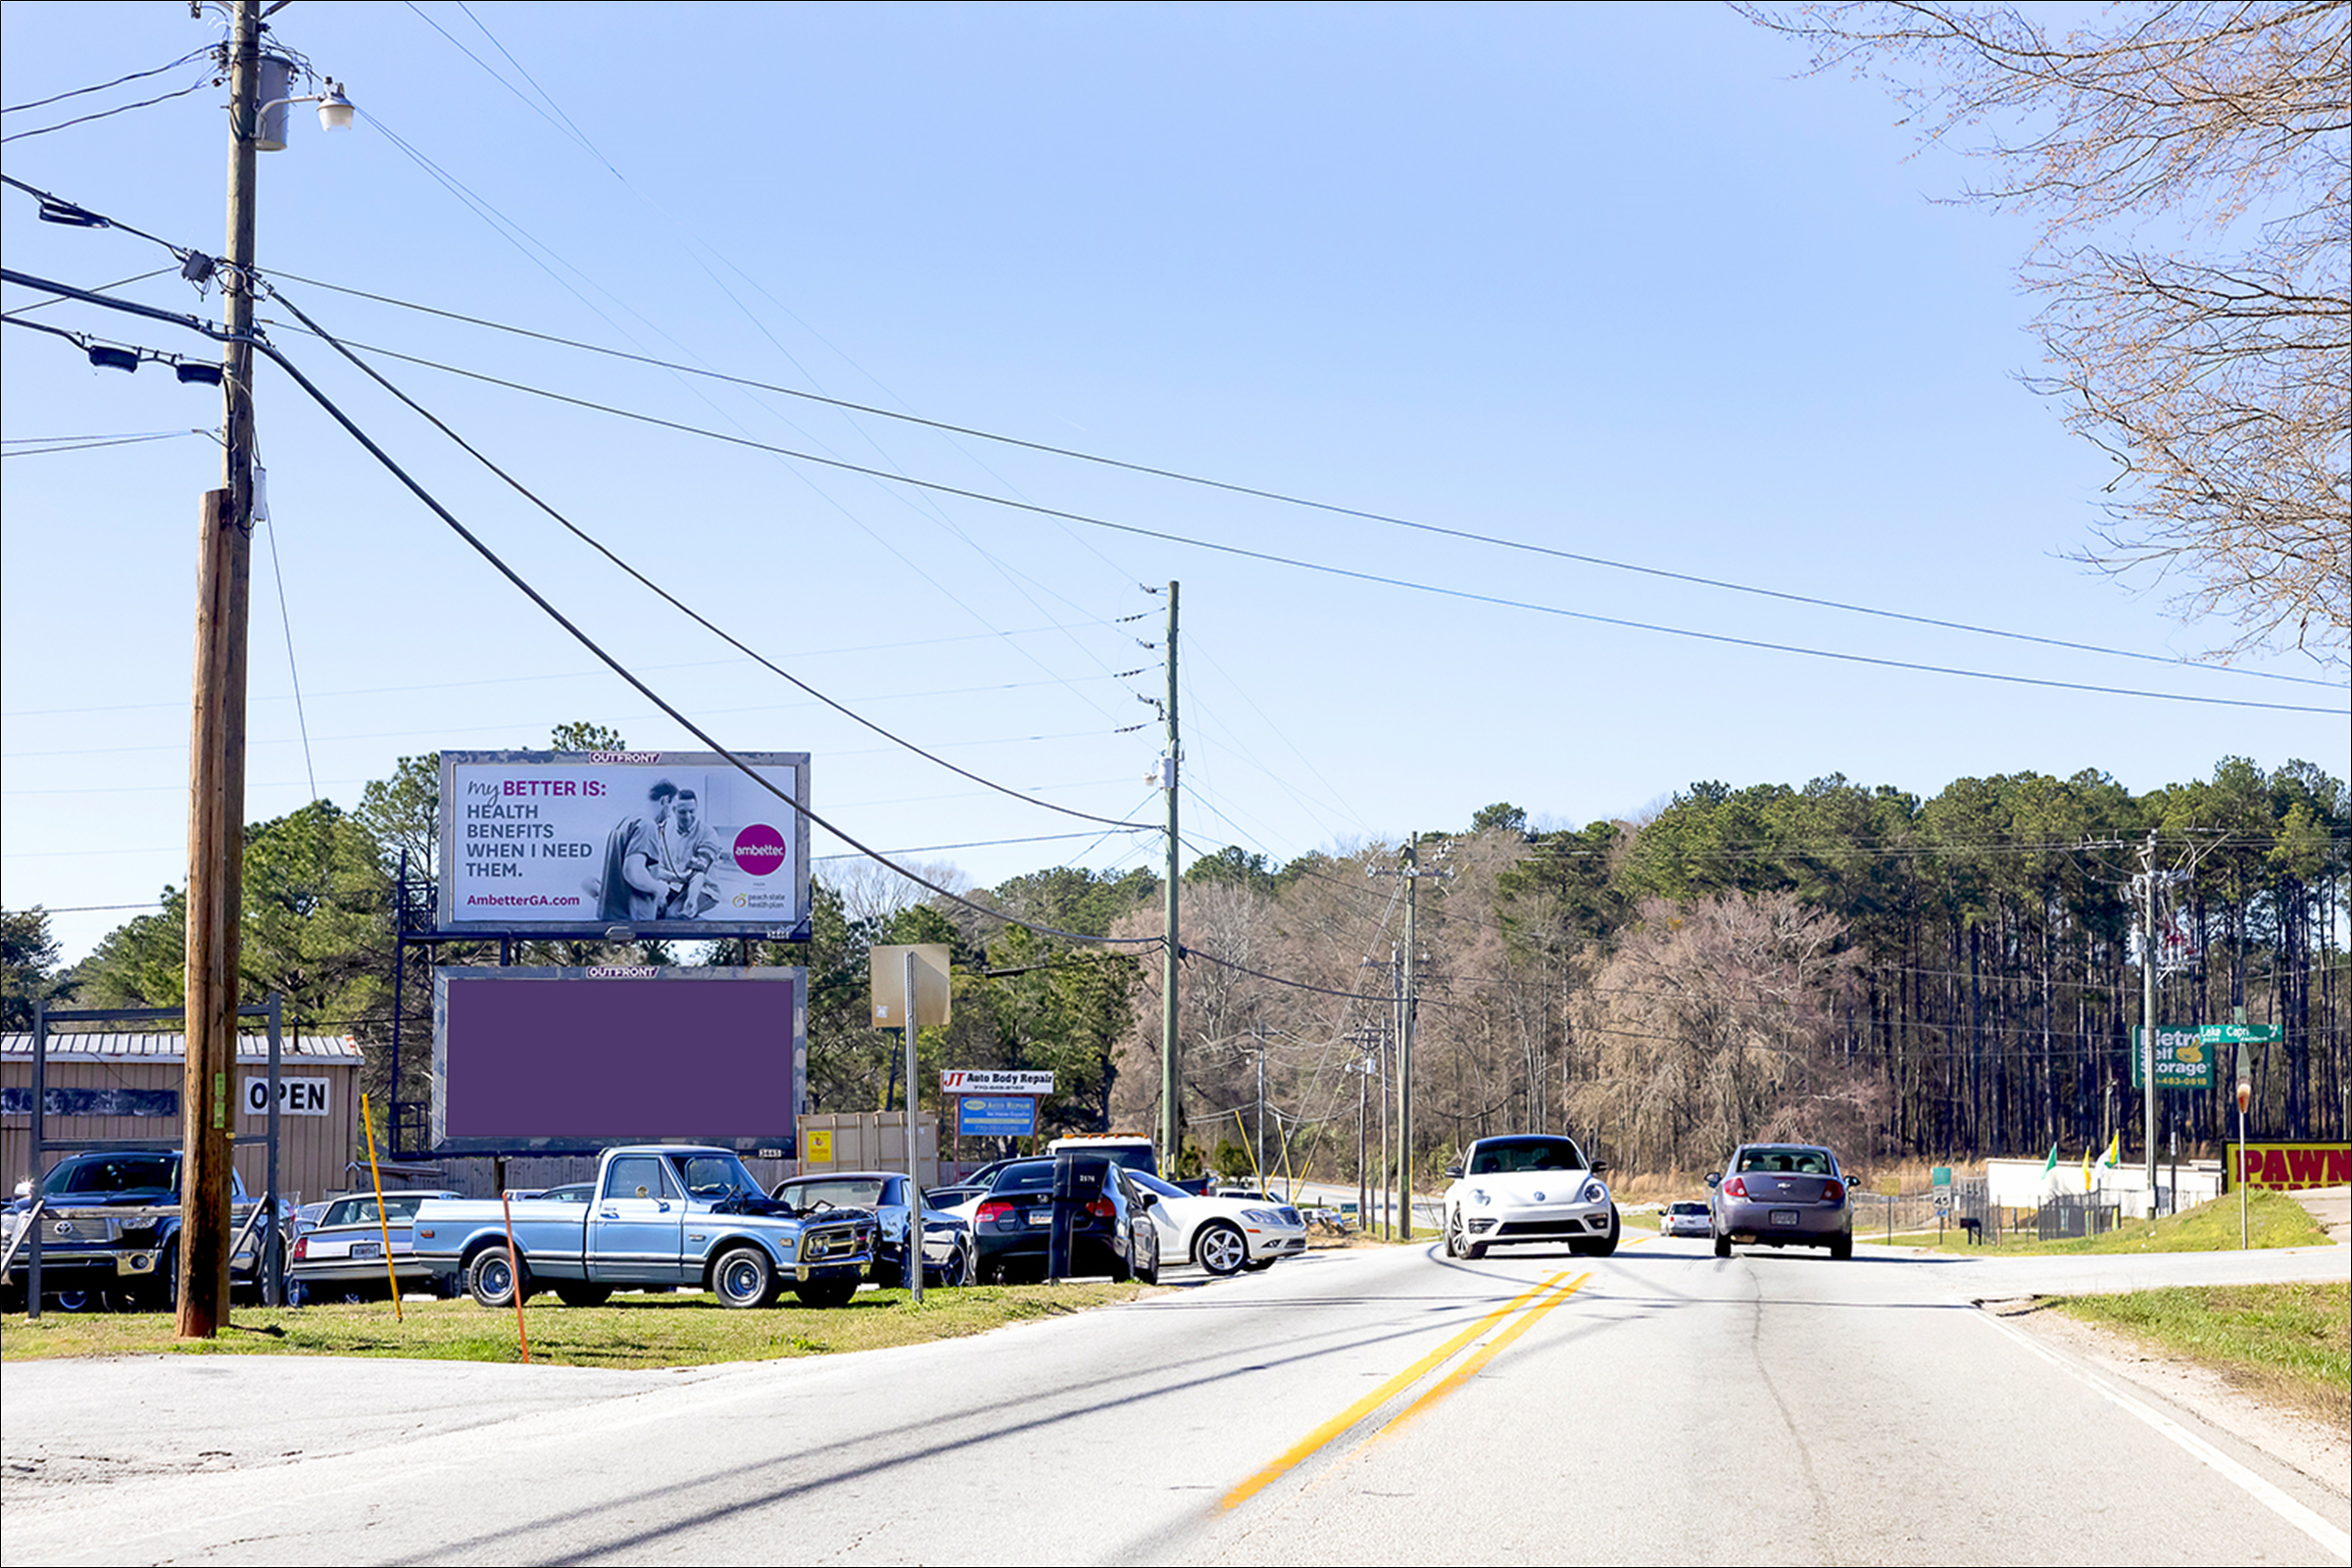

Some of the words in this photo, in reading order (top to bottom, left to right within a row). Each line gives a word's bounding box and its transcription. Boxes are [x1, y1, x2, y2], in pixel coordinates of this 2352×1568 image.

[592, 752, 657, 763] OUTFRONT
[467, 781, 500, 808] my
[503, 780, 576, 796] BETTER
[582, 780, 607, 796] IS:
[467, 805, 538, 819] HEALTH
[467, 824, 554, 838] BENEFITS
[466, 844, 524, 858] WHEN
[531, 844, 536, 858] I
[543, 844, 593, 858] NEED
[466, 862, 522, 877] THEM.
[466, 894, 580, 906] AmbetterGA.com
[589, 966, 655, 978] OUTFRONT
[2200, 1025, 2221, 1037] Lake
[2226, 1025, 2250, 1039] Capri
[2140, 1063, 2206, 1076] orage
[944, 1072, 965, 1087] JT
[966, 1073, 990, 1083] Auto
[993, 1073, 1018, 1085] Body
[1020, 1073, 1054, 1085] Repair
[2235, 1150, 2351, 1182] PAWN
[1935, 1197, 1949, 1206] 45
